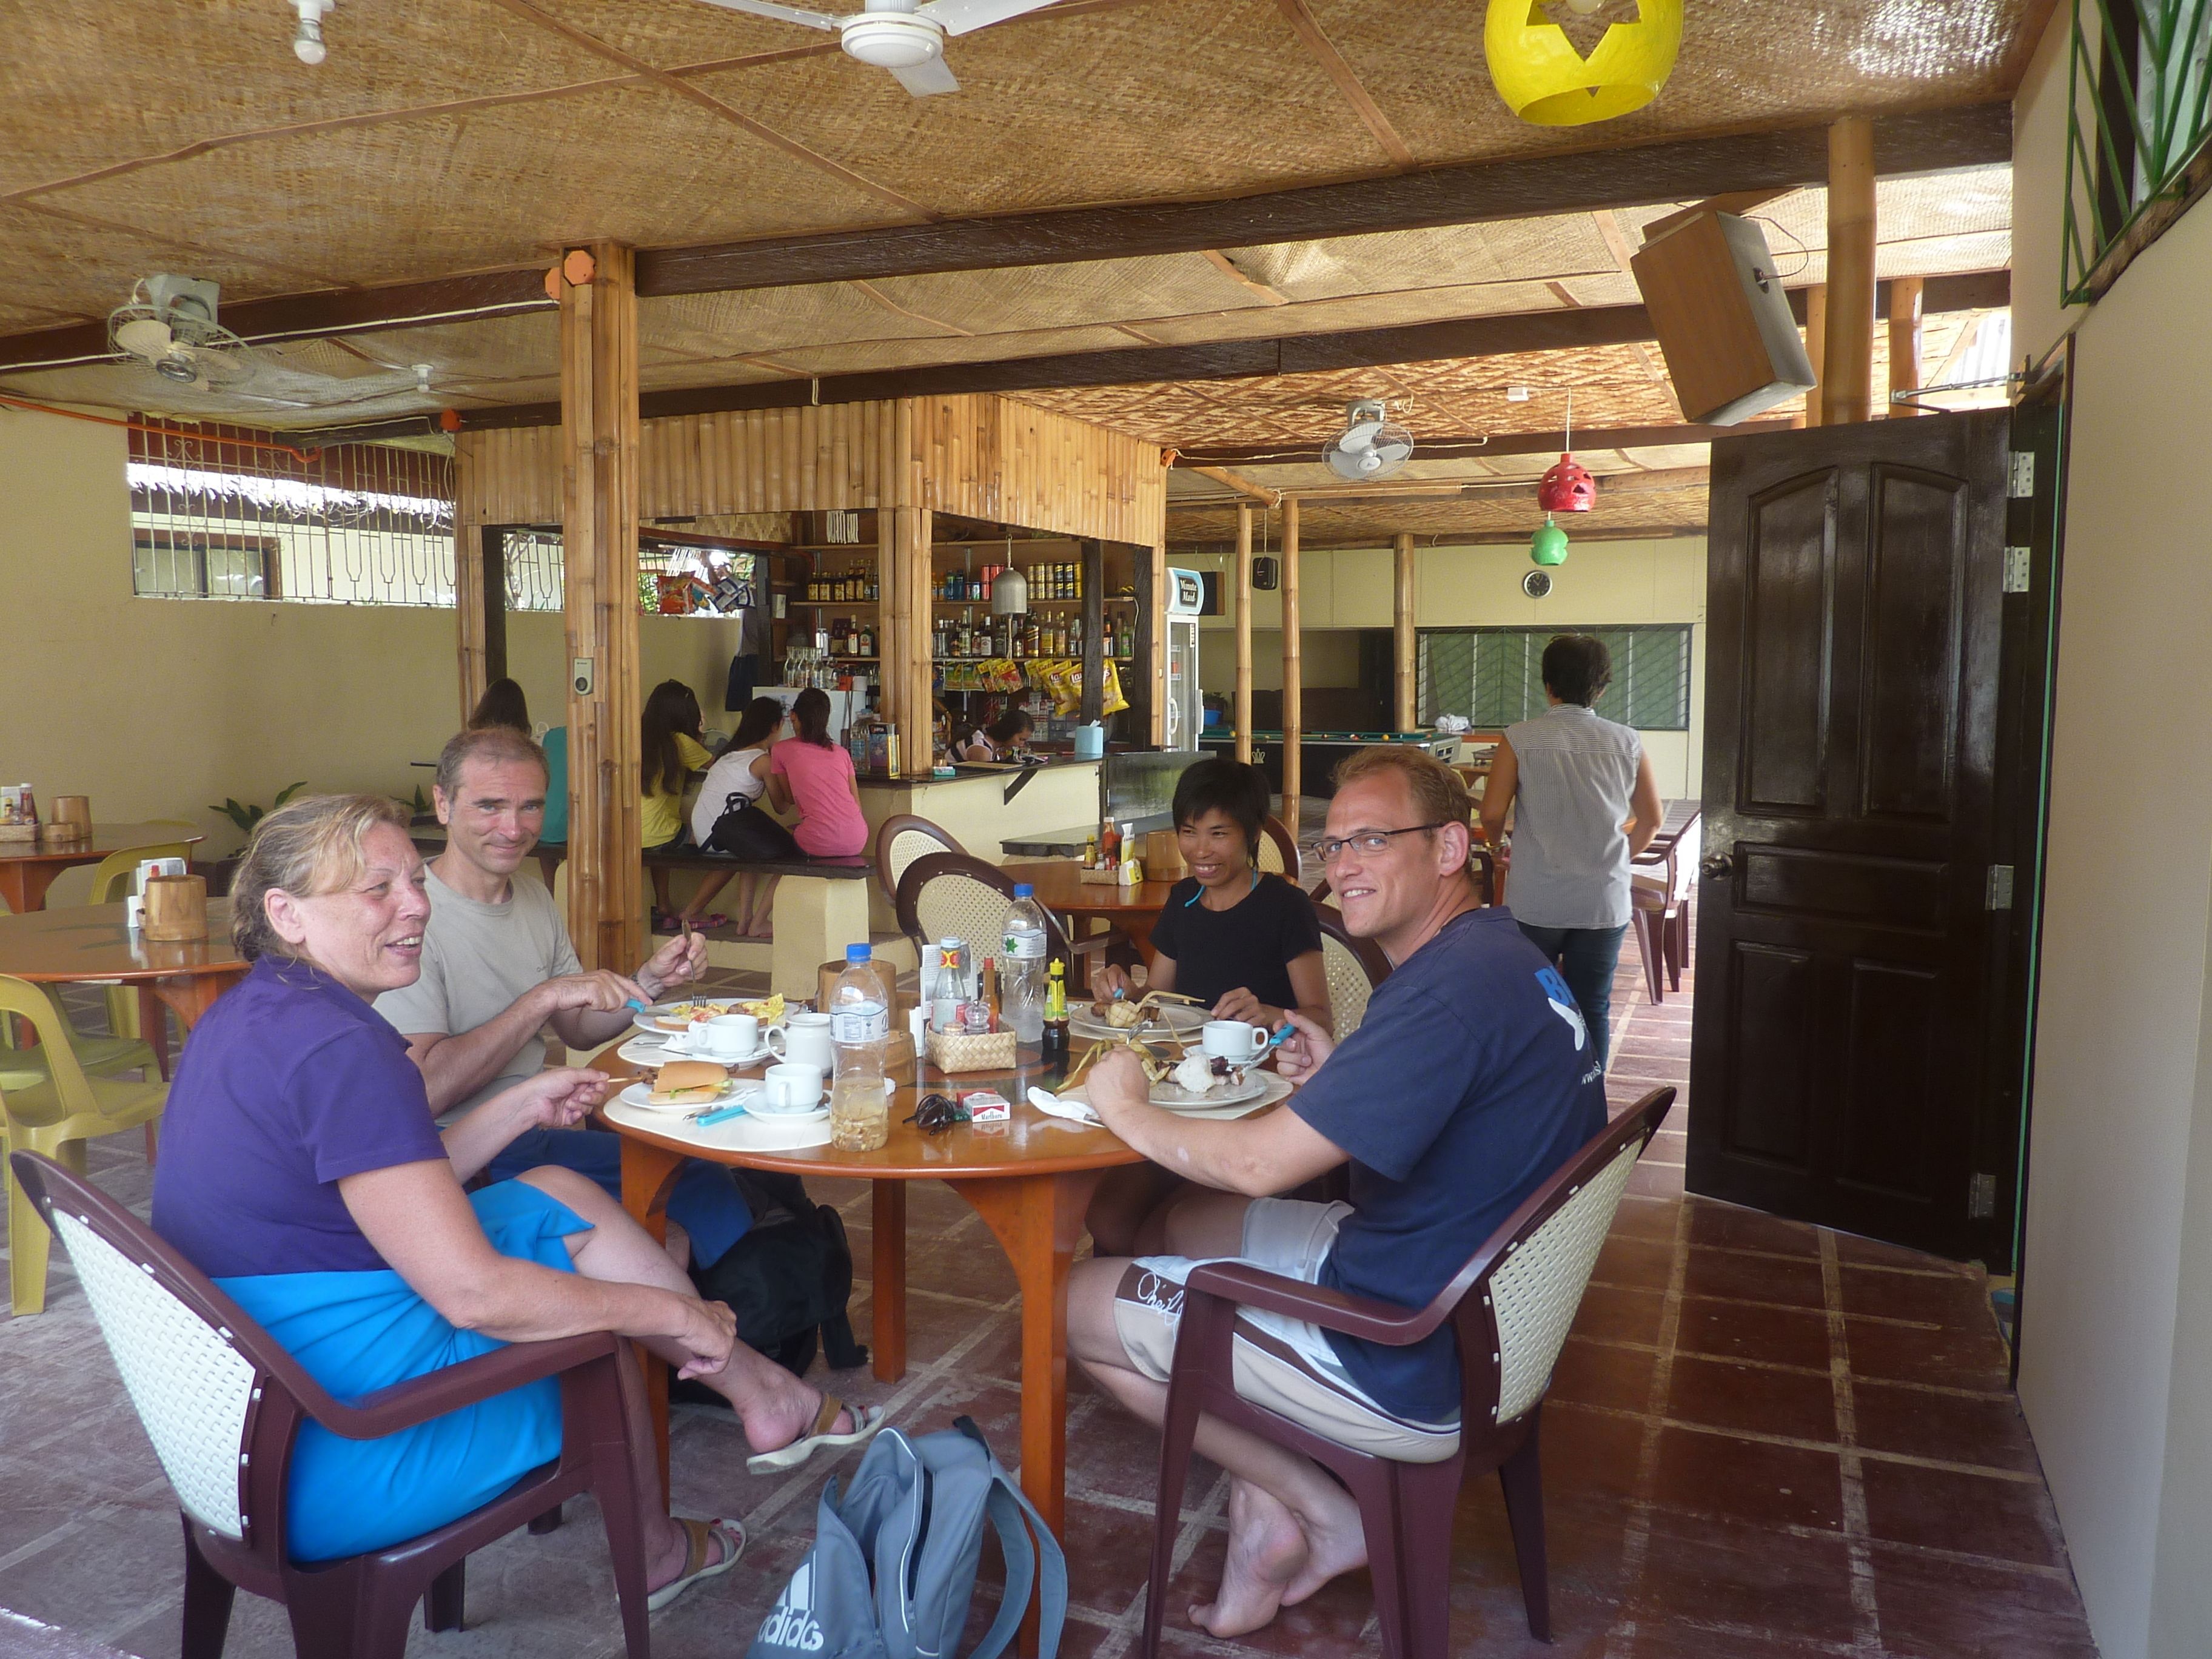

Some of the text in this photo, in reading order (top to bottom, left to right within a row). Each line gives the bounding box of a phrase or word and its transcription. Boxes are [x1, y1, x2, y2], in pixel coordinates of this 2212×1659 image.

[1180, 579, 1197, 591] Minute
[1182, 591, 1196, 602] Maid
[981, 1111, 1003, 1120] Marlboro
[757, 1606, 824, 1651] adidas
